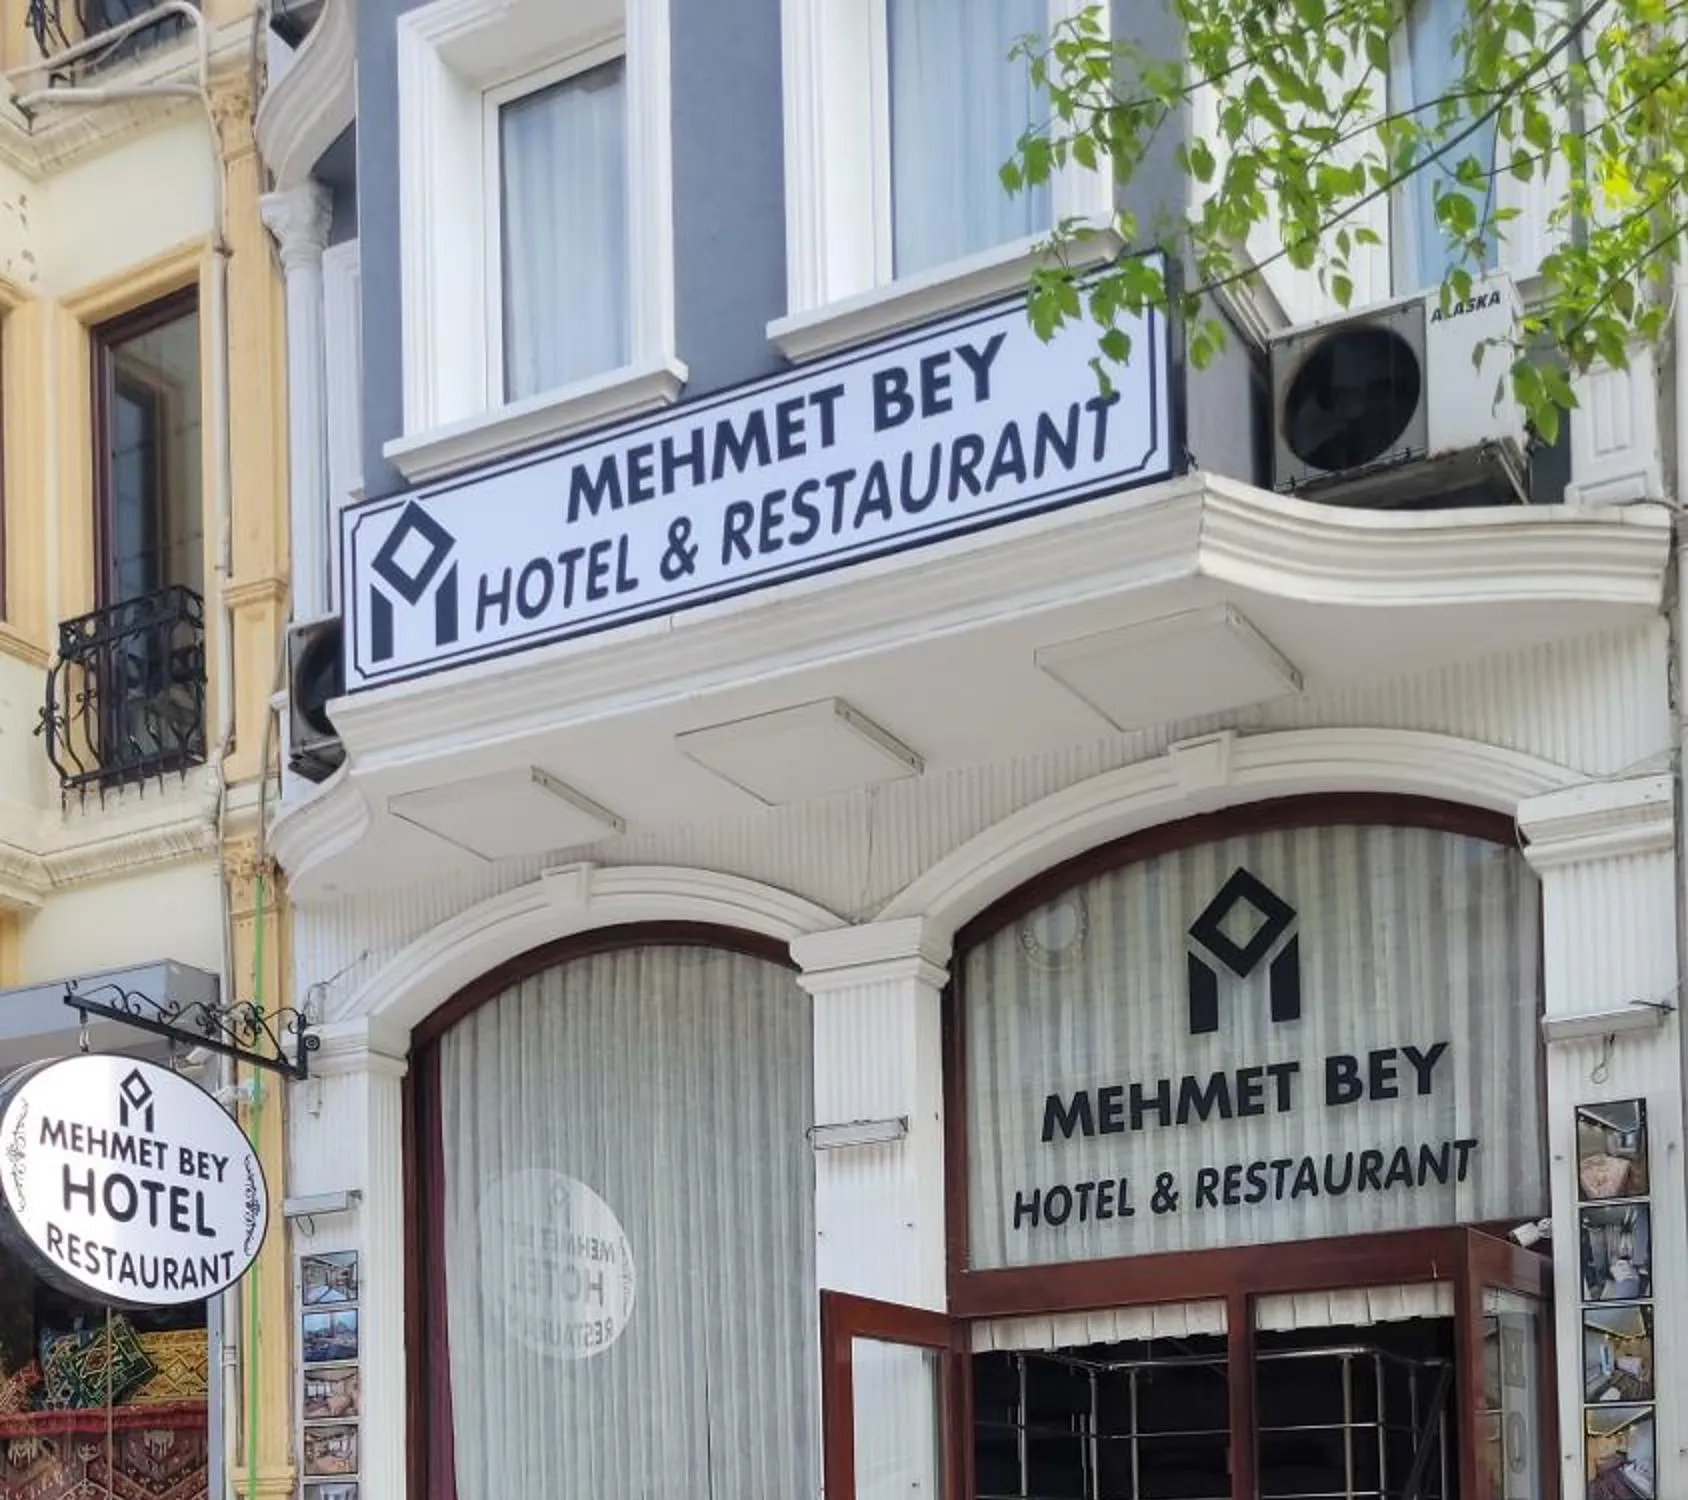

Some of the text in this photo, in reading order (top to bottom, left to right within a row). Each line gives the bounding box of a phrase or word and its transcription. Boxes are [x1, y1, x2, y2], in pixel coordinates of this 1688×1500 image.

[1429, 290, 1501, 323] AASKA
[567, 332, 1008, 523] MEHMET BEY
[475, 392, 1121, 632] HOTEL & RESTAURANT
[1041, 1041, 1450, 1143] MEHMET BEY
[40, 1116, 229, 1183] MEHMET BEY
[1013, 1138, 1479, 1230] HOTEL & RESTAURANT
[62, 1163, 217, 1238] HOTEL
[46, 1220, 235, 1291] RESTAURANT
